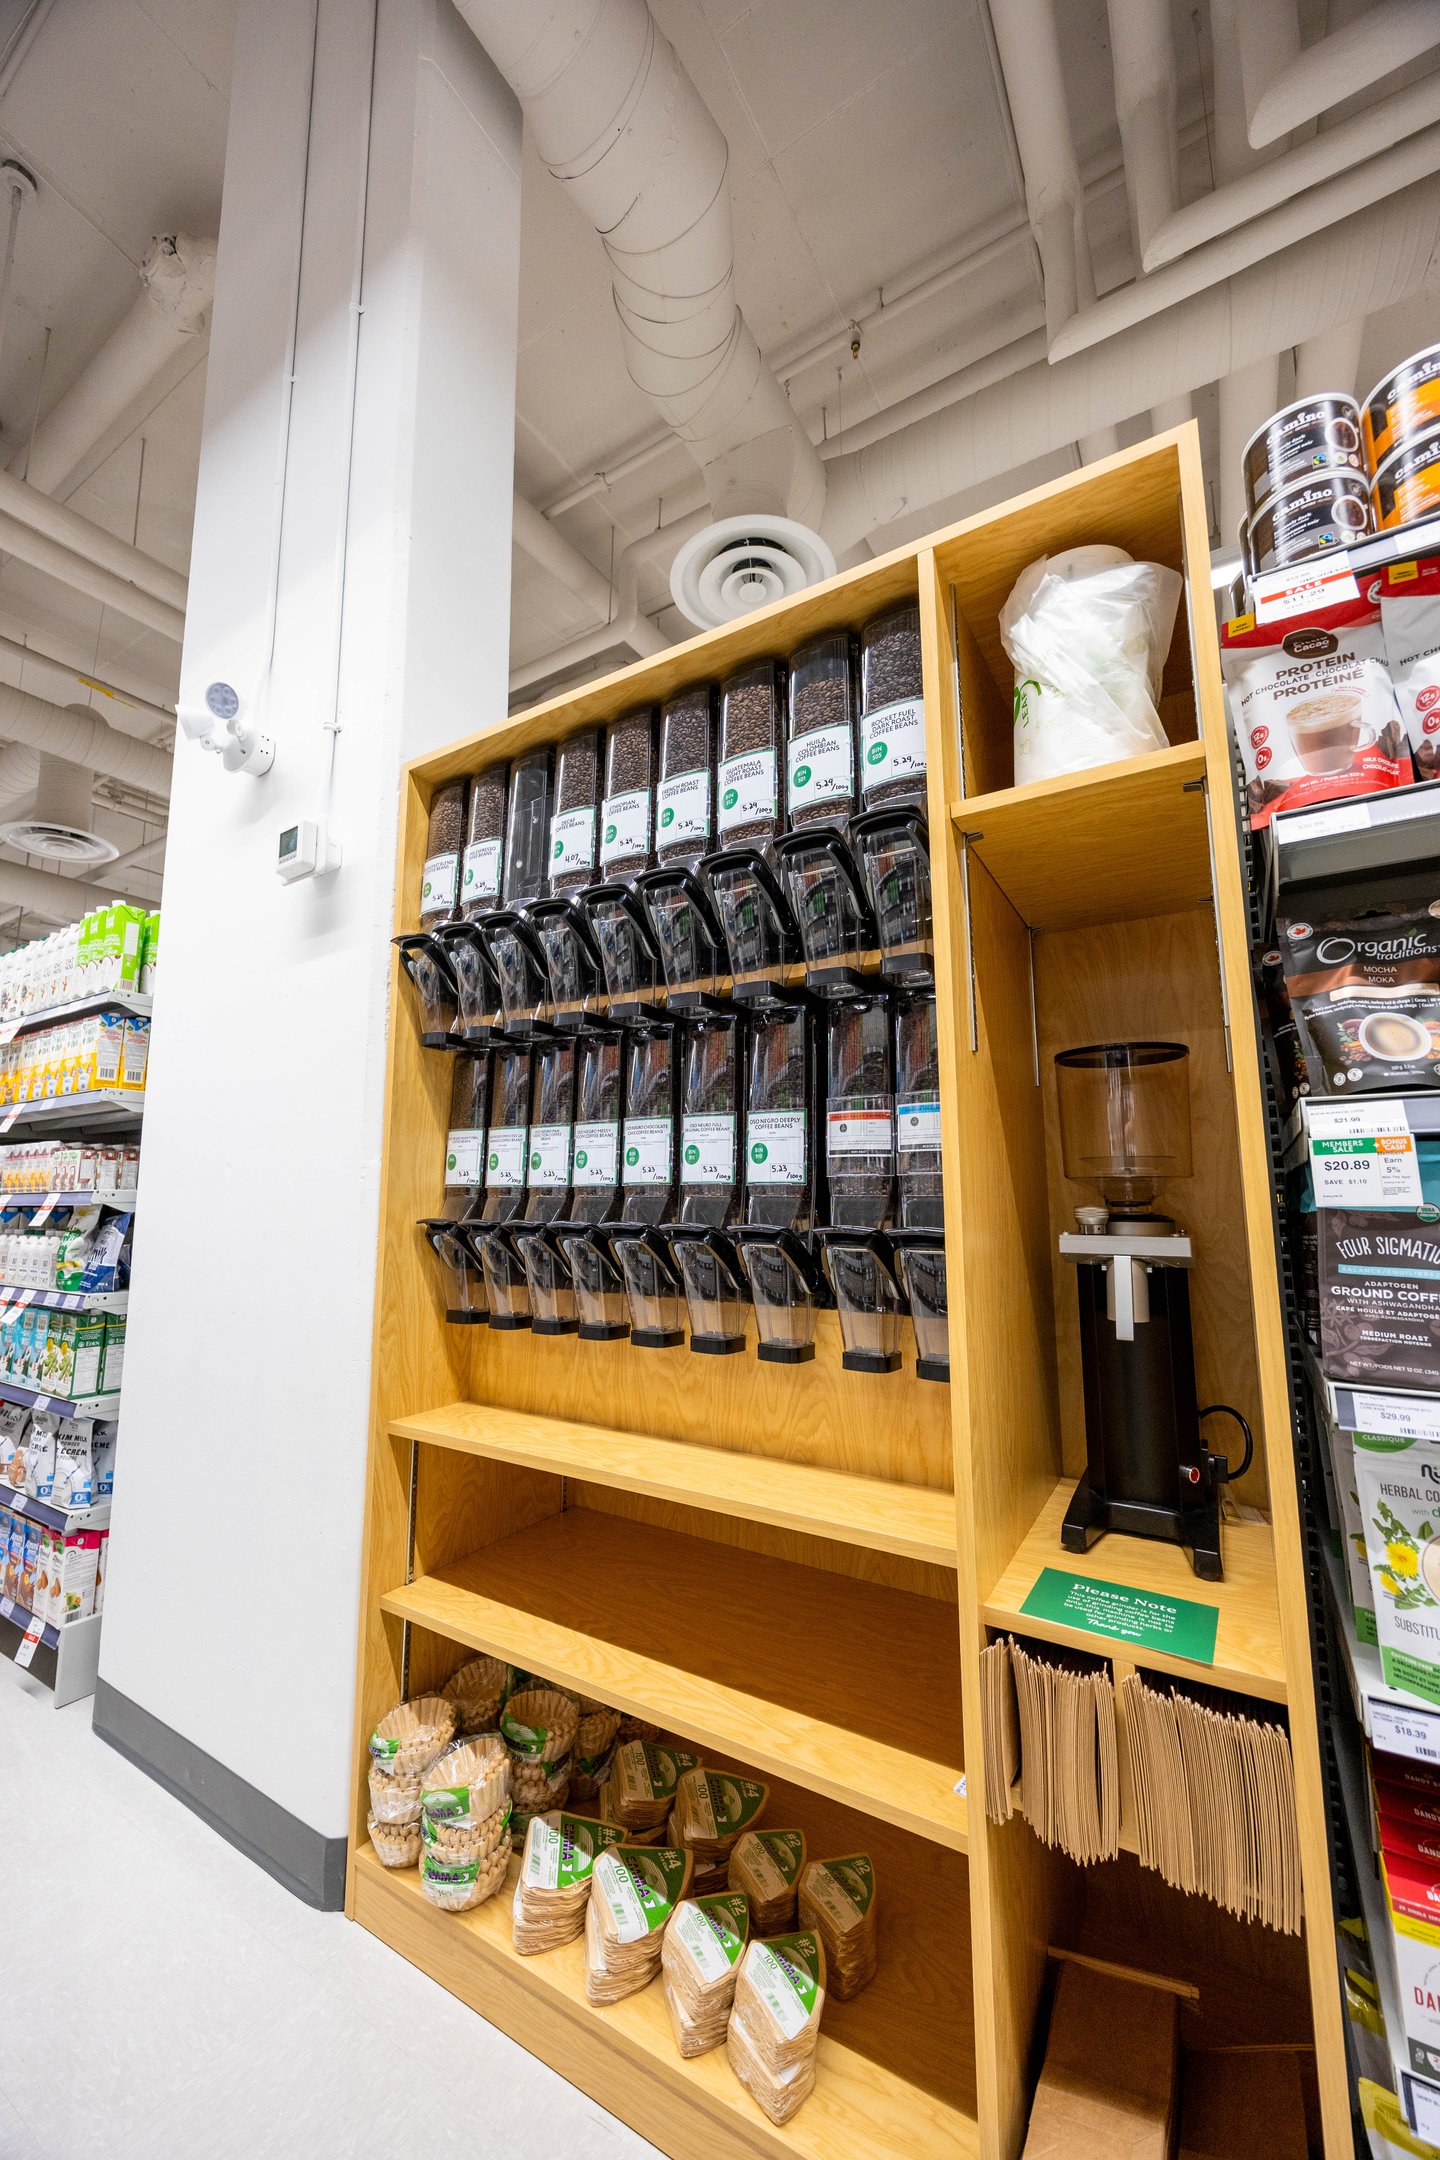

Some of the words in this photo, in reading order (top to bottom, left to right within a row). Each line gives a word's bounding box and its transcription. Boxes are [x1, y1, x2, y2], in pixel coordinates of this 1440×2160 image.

[1387, 361, 1440, 400] camin
[1395, 441, 1440, 480] cami
[1272, 488, 1332, 521] camino
[1285, 580, 1323, 595] SALE
[1294, 639, 1330, 653] Cacao
[1276, 652, 1355, 680] PROTEIN
[1400, 653, 1421, 667] HOT
[1241, 692, 1254, 706] HOT
[1255, 674, 1309, 695] CHOCOLATE
[1315, 659, 1366, 677] CHOCOLAT
[1273, 666, 1364, 700] PROTÉINÉ
[871, 713, 897, 728] ROCKET
[898, 709, 916, 718] FUEL
[872, 722, 890, 733] DARK
[891, 714, 914, 725] ROAST
[869, 727, 893, 739] COFFEE
[895, 719, 919, 730] BEANS
[797, 740, 837, 756] COLOMBIAN
[806, 737, 826, 747] HUILA
[795, 751, 817, 763] COFFEE
[818, 745, 840, 754] BEANS
[893, 755, 912, 766] 5.29
[725, 760, 761, 775] GUATEMALA
[725, 771, 742, 780] LIGHT
[742, 765, 762, 774] ROAST
[724, 776, 744, 786] COFFEE
[744, 769, 765, 779] BEANS
[816, 778, 834, 790] 5.29
[831, 781, 849, 792] /100g
[661, 785, 680, 795] FRENCH
[680, 780, 699, 788] ROAST
[662, 791, 679, 800] COFFEE
[623, 803, 640, 812] BEANS
[742, 802, 758, 812] 5.29
[755, 807, 773, 815] /100g
[569, 820, 585, 828] BEANS
[677, 820, 693, 829] 5.29
[620, 838, 633, 846] 5.29
[1317, 933, 1428, 964] Organic
[1376, 945, 1438, 961] traditions
[1363, 965, 1398, 974] MOCHA
[1368, 975, 1395, 984] MOKA
[1322, 1140, 1363, 1148] MEMBERS
[1332, 1145, 1353, 1153] SALE
[1381, 1138, 1407, 1146] BONUS
[703, 1165, 718, 1173] 5.23
[715, 1172, 731, 1180] /100g
[1324, 1160, 1370, 1171] $20.89
[1386, 1166, 1401, 1174] 5%
[786, 1172, 803, 1180] /100g
[1336, 1237, 1372, 1259] FOUR
[1376, 1236, 1440, 1265] SIGMATIC
[1364, 1280, 1419, 1290] ADAPTOGEN
[1331, 1285, 1393, 1300] GROUND
[1397, 1291, 1440, 1303] COFF
[1347, 1298, 1369, 1306] WITH
[1371, 1300, 1440, 1312] ASHWAGANDHA
[1357, 1307, 1383, 1315] MOULU
[1361, 1330, 1397, 1339] MEDIUM
[1399, 1333, 1429, 1342] ROAST
[1380, 1412, 1411, 1422] $29.99
[1362, 1434, 1406, 1443] CLASSIQUE
[1380, 1483, 1423, 1500] HERBAL
[1425, 1489, 1440, 1503] CO
[1073, 1584, 1129, 1602] Please
[1134, 1598, 1177, 1614] Note
[1087, 1595, 1110, 1604] coffee
[1111, 1602, 1139, 1611] grinder
[1074, 1605, 1093, 1613] used
[1106, 1613, 1139, 1626] grinding
[1139, 1621, 1162, 1631] herbs
[1091, 1600, 1123, 1613] grinding
[1124, 1609, 1149, 1618] coffee
[1151, 1615, 1175, 1625] beans
[1102, 1607, 1135, 1619] machine
[1085, 1612, 1107, 1621] other
[1107, 1618, 1145, 1632] products.
[1086, 1617, 1120, 1631] Thank
[1120, 1628, 1142, 1637] you
[1394, 1615, 1440, 1641] SUBSTITU
[1394, 1725, 1427, 1740] $18.39
[635, 1751, 645, 1766] 100
[697, 1783, 708, 1799] 100
[746, 1782, 760, 1798] #4
[548, 1825, 560, 1844] 100
[602, 1828, 616, 1845] #4
[786, 1833, 801, 1848] #2
[754, 1842, 766, 1855] 100
[662, 1850, 682, 1869] #4
[854, 1859, 871, 1874] #2
[614, 1863, 629, 1884] 100
[822, 1872, 836, 1885] 100
[731, 1897, 747, 1914] #2
[693, 1911, 707, 1928] 100
[798, 1938, 817, 1957] #2
[763, 1953, 778, 1970] 100
